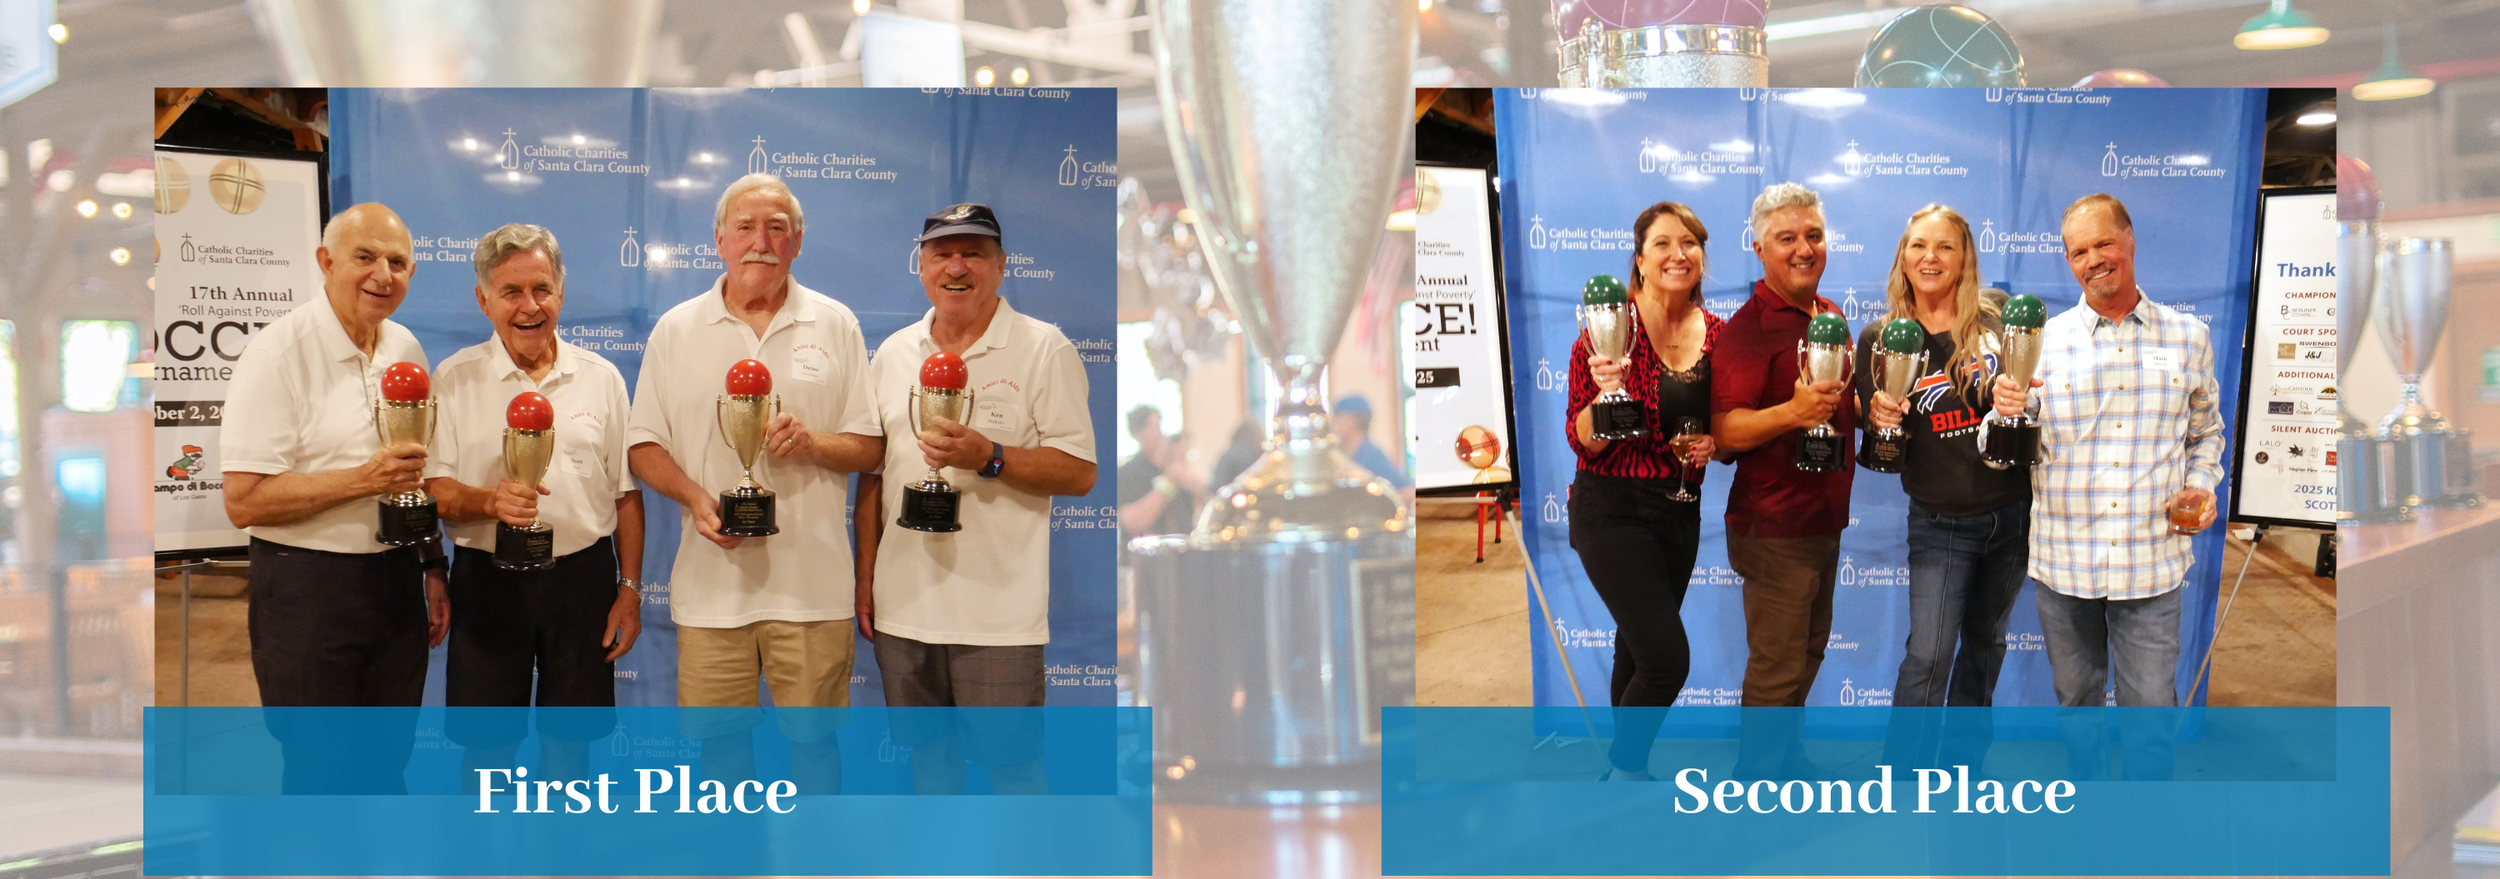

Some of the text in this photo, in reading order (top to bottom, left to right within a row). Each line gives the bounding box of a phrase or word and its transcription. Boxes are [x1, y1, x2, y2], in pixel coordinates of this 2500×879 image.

[1028, 88, 1071, 101] County
[2006, 92, 2112, 106] of Santa Clara County
[524, 146, 628, 159] Catholic Charities
[1702, 152, 1745, 163] Charities
[772, 152, 876, 166] Catholic Charities
[1864, 153, 1950, 165] Catholic Charities
[2121, 155, 2161, 166] Catholic
[524, 160, 650, 176] of Santa Clara County
[1659, 163, 1764, 176] of Santa Clara County
[1864, 164, 1968, 177] of Santa Clara County
[2121, 167, 2226, 179] of Santa Clara County
[771, 165, 897, 183] of Santa Clara County
[1081, 176, 1092, 189] of
[1549, 229, 1634, 239] Catholic Charities
[1999, 232, 2037, 242] Catholic
[198, 245, 274, 256] Catholic Charities
[1418, 241, 1450, 249] Charities
[1550, 240, 1614, 251] of Santa Clara
[1829, 242, 1864, 254] County
[1999, 243, 2063, 254] of Santa Clara
[436, 251, 467, 262] Clara
[1439, 250, 1465, 258] County
[199, 254, 290, 268] of Santa Clara County
[657, 257, 723, 269] Santa Clara
[1014, 267, 1055, 281] County
[2277, 262, 2336, 277] Thank
[1417, 274, 1468, 286] Annual
[190, 285, 293, 302] 17th Annual
[207, 305, 252, 319] Against
[255, 306, 292, 317] Povert
[1861, 311, 1870, 322] of
[572, 326, 624, 338] Charities
[604, 339, 645, 354] County
[1069, 339, 1113, 350] Catholic
[2278, 371, 2335, 379] ADDITIONAL
[1556, 382, 1565, 393] of
[190, 405, 206, 422] 2,
[2271, 425, 2302, 433] SILENT
[188, 481, 198, 491] di
[2294, 484, 2323, 495] 2025
[1052, 506, 1097, 517] Catholic
[1051, 518, 1095, 531] of Santa
[1858, 567, 1894, 577] Catholic
[1708, 577, 1732, 585] Clara
[1858, 577, 1895, 587] of Santa
[1571, 629, 1605, 639] Catholic
[1571, 639, 1606, 648] of Santa
[1827, 641, 1859, 651] County
[2019, 642, 2042, 650] Clara
[1043, 664, 1082, 675] Catholic
[1050, 676, 1111, 687] Santa Clara
[1858, 688, 1892, 698] Catholic
[1677, 697, 1685, 706] of
[1858, 698, 1892, 706] of Santa
[633, 737, 675, 747] Catholic
[633, 748, 675, 759] of Santa
